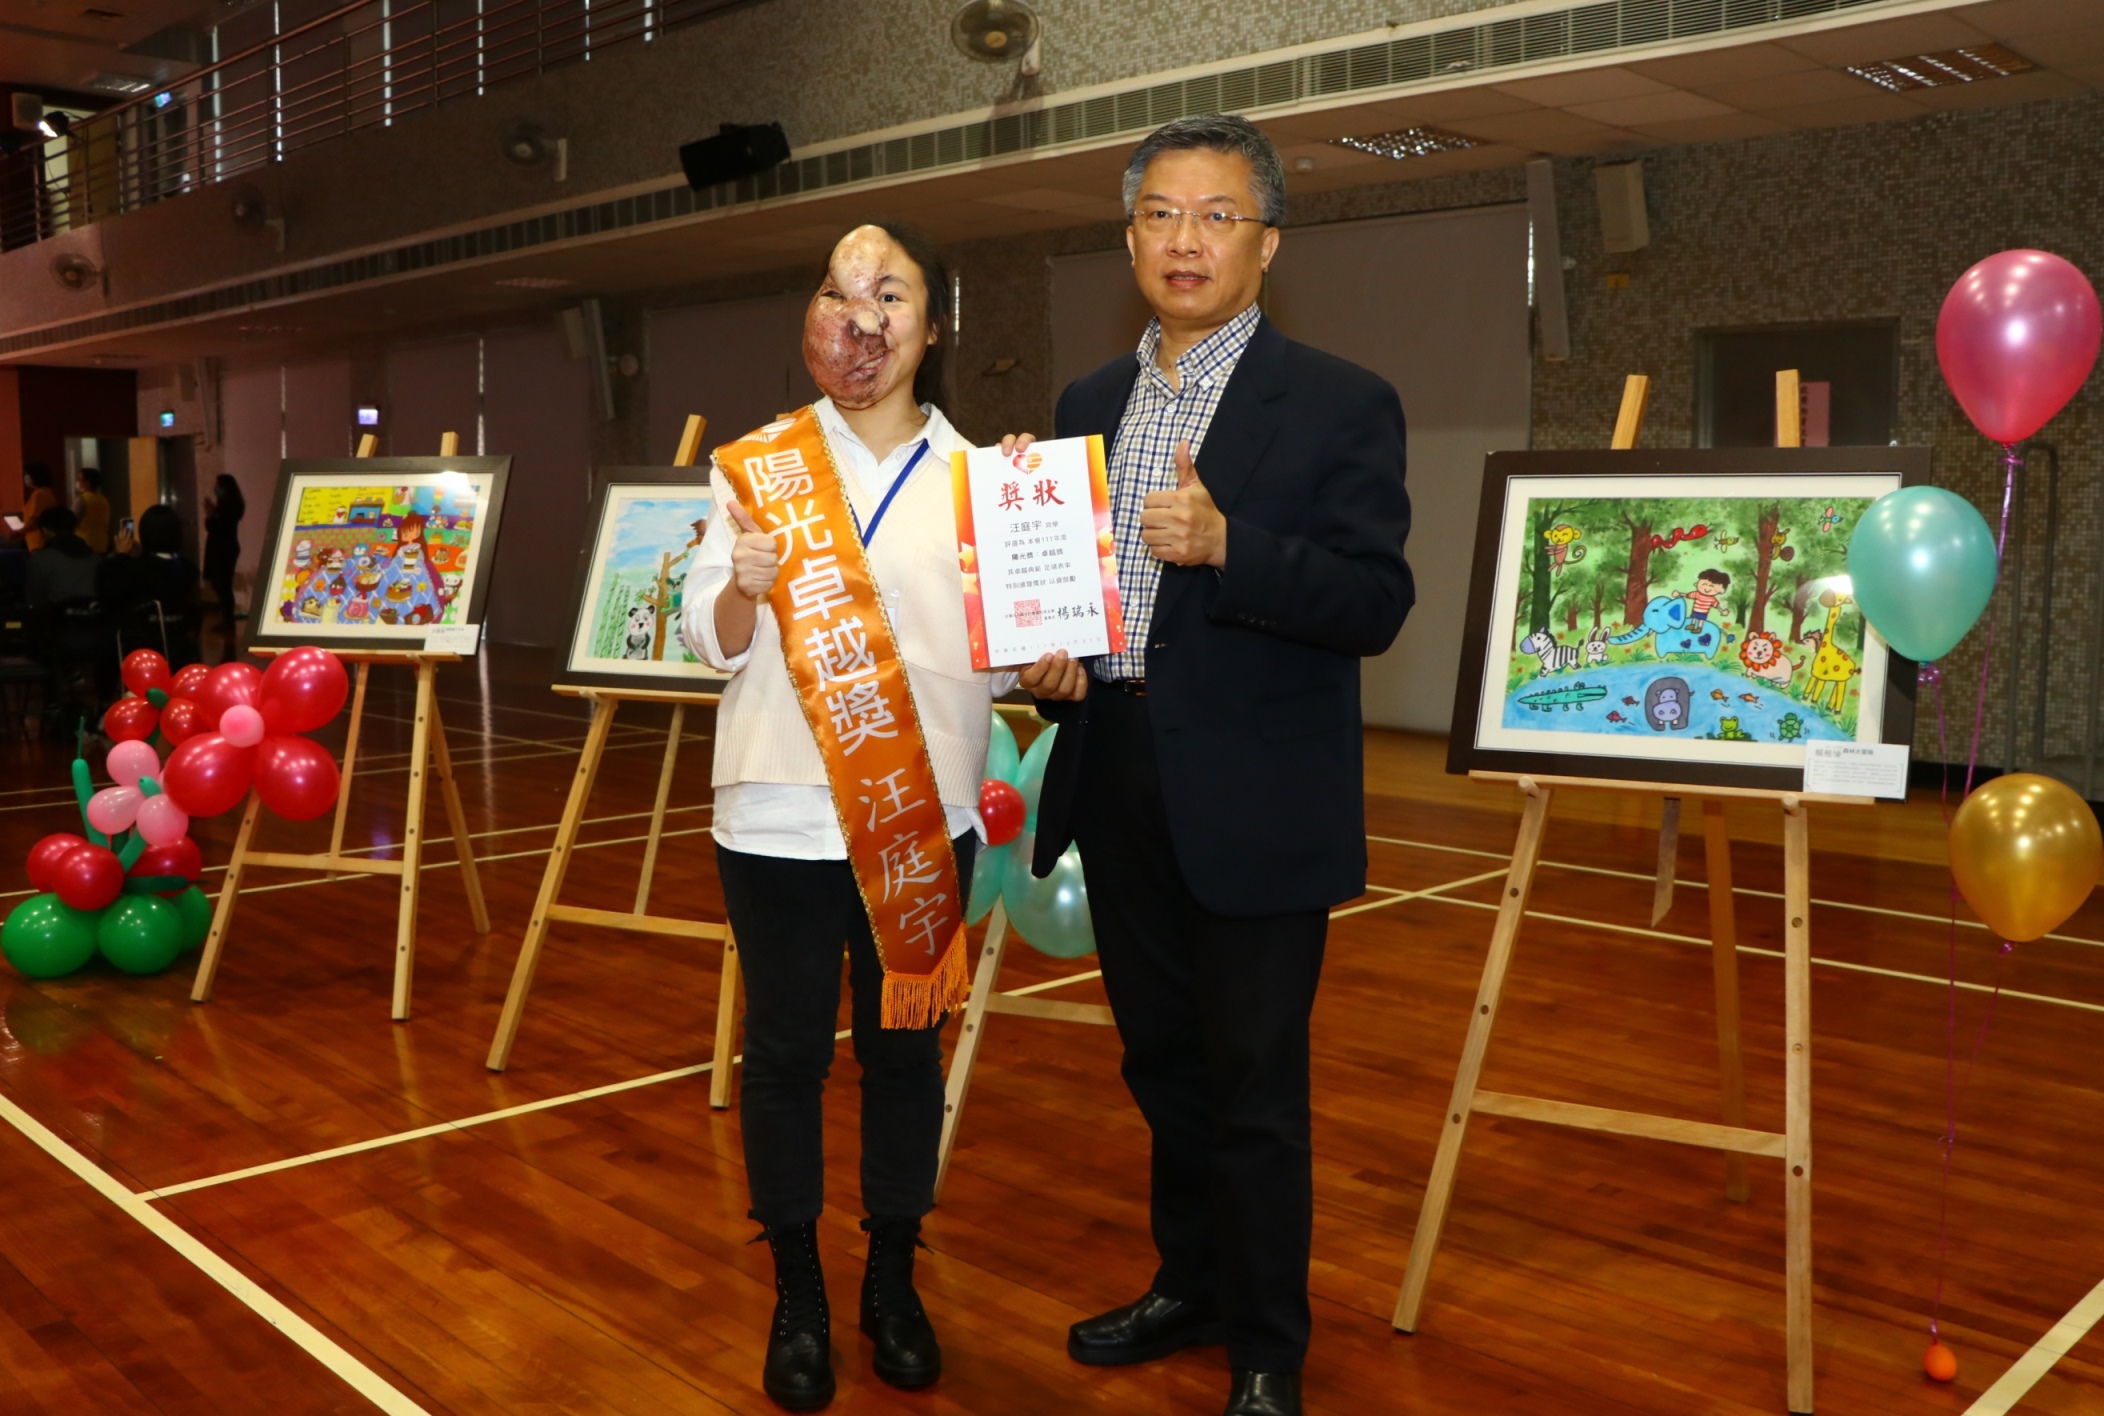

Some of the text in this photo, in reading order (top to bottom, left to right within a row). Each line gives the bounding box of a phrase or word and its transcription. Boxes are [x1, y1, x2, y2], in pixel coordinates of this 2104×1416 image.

[1010, 520, 1042, 533] 汪庭宇
[743, 447, 950, 955] 陽光卓越獎 汪庭宇
